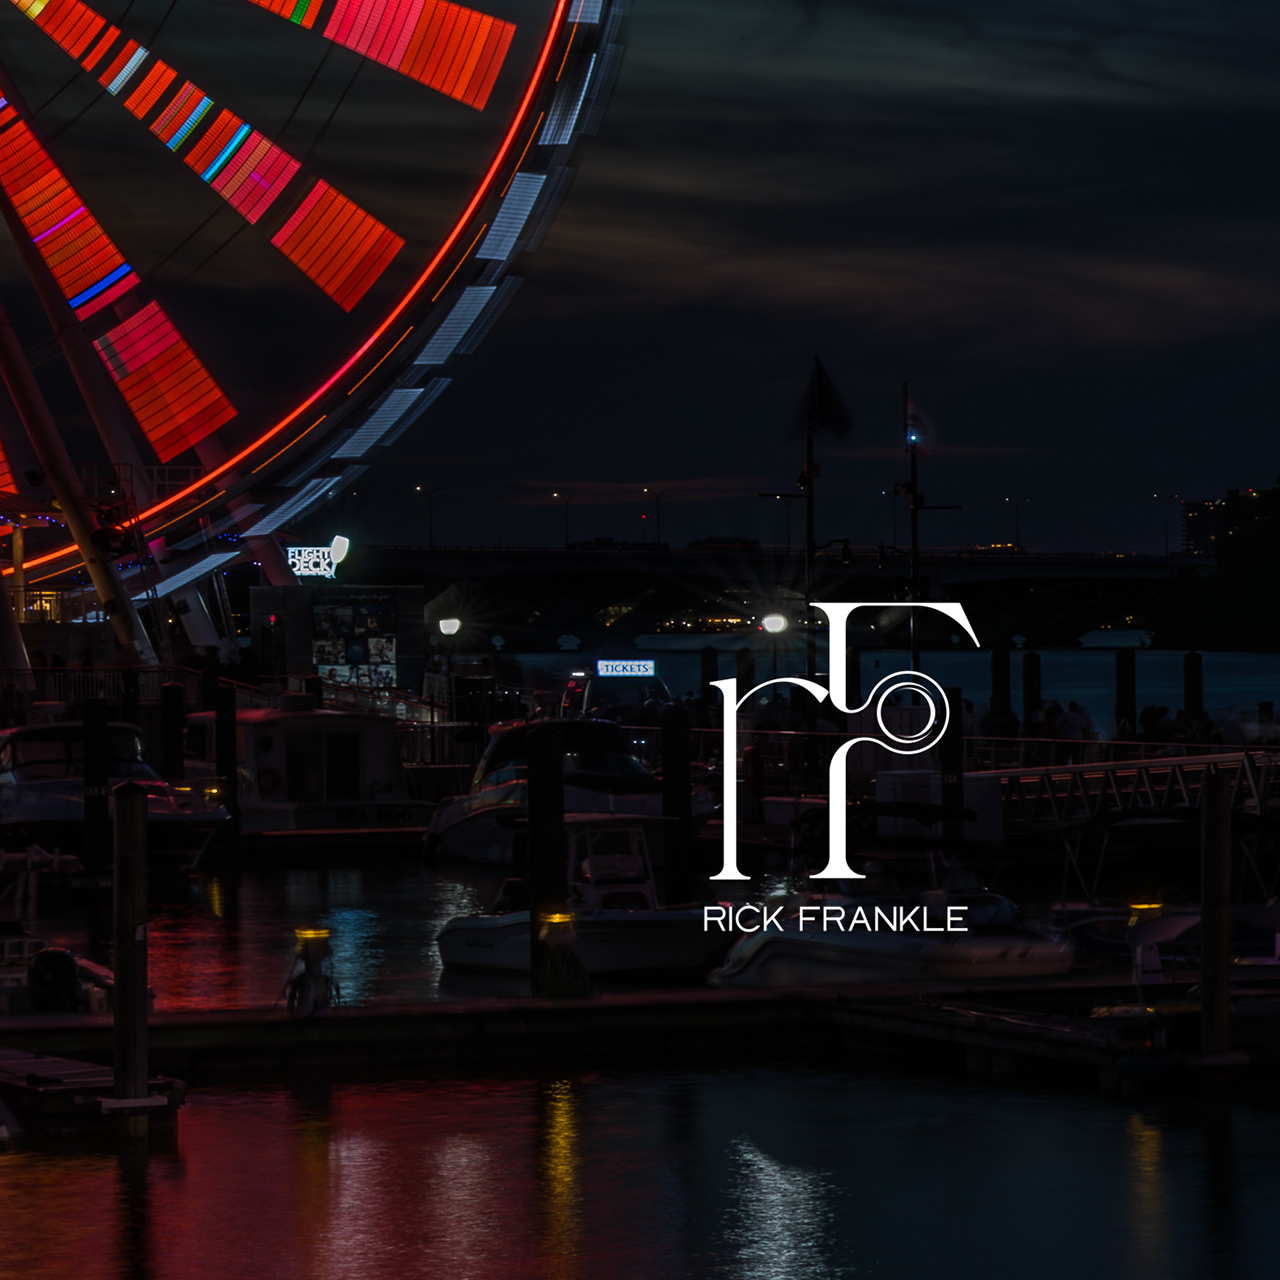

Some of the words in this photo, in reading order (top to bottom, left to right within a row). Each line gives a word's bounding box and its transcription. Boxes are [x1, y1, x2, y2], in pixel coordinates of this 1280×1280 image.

[288, 549, 331, 559] FLIGHT
[288, 558, 331, 572] DECK
[604, 663, 649, 674] TICKETS
